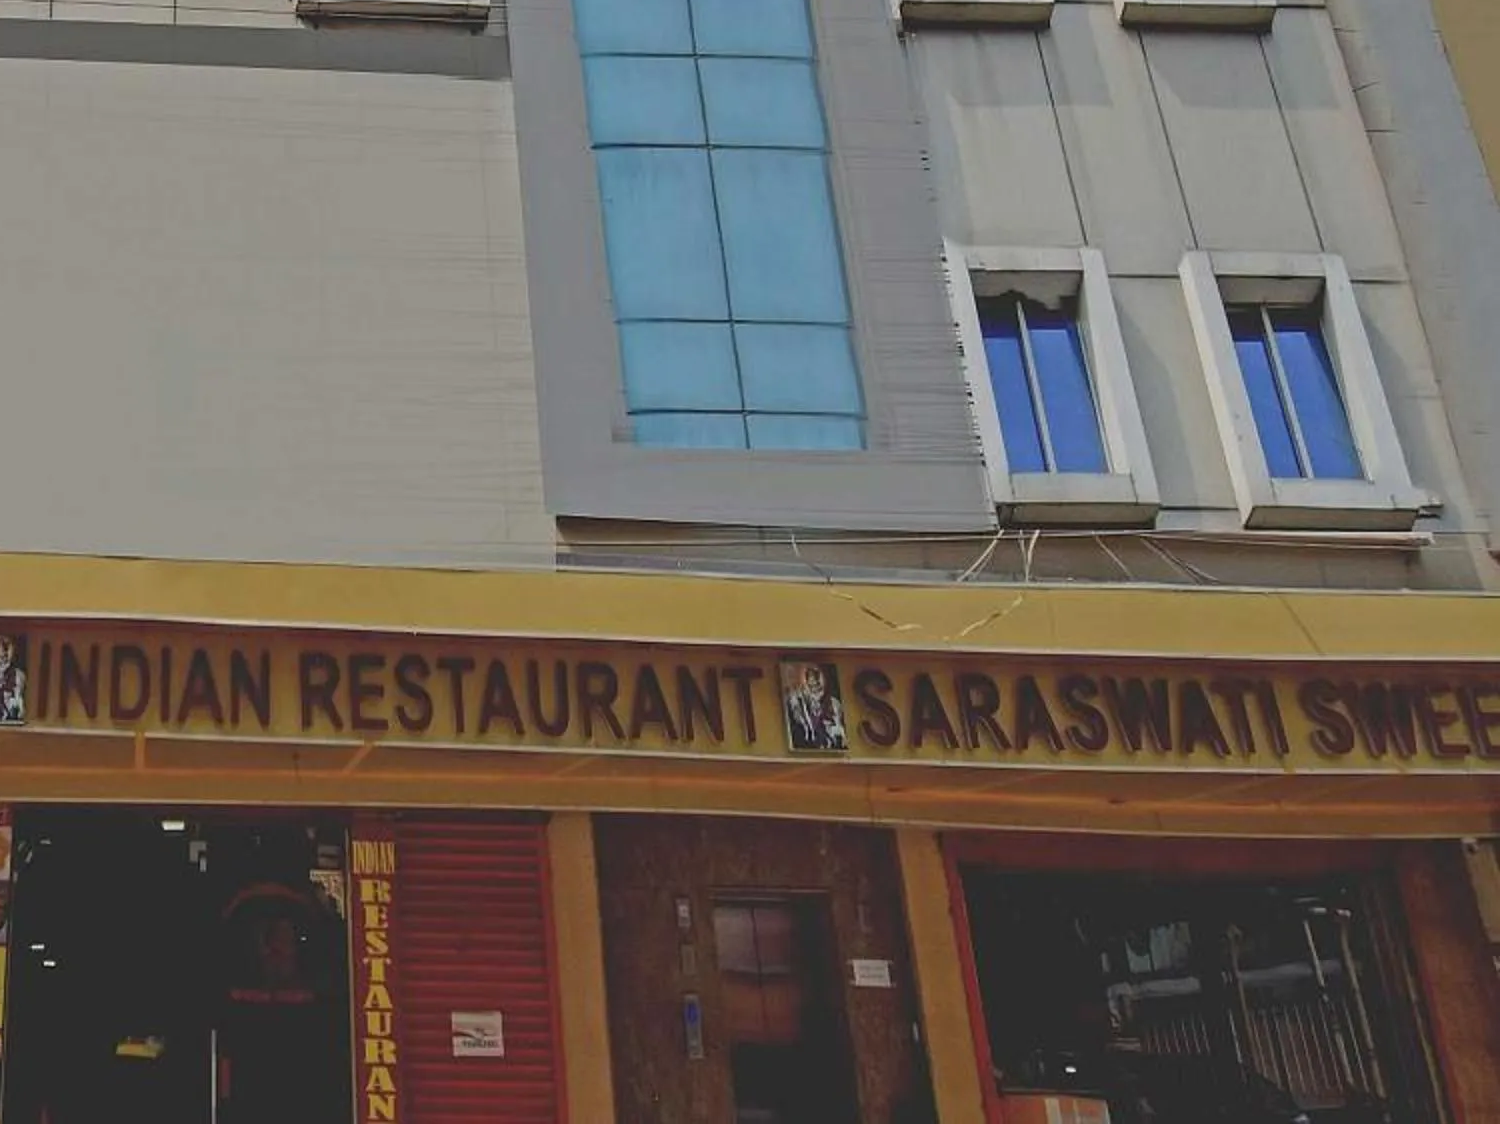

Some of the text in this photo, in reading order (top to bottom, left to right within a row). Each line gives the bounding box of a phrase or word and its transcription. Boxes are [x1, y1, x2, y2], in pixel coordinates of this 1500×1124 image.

[36, 641, 271, 726] INDIAN
[298, 651, 764, 744] RESTAURANT
[853, 668, 1290, 757] SARASWATI
[1297, 678, 1500, 760] SWEE
[351, 840, 396, 875] INDIAN
[359, 879, 397, 1124] RESTAURAN
